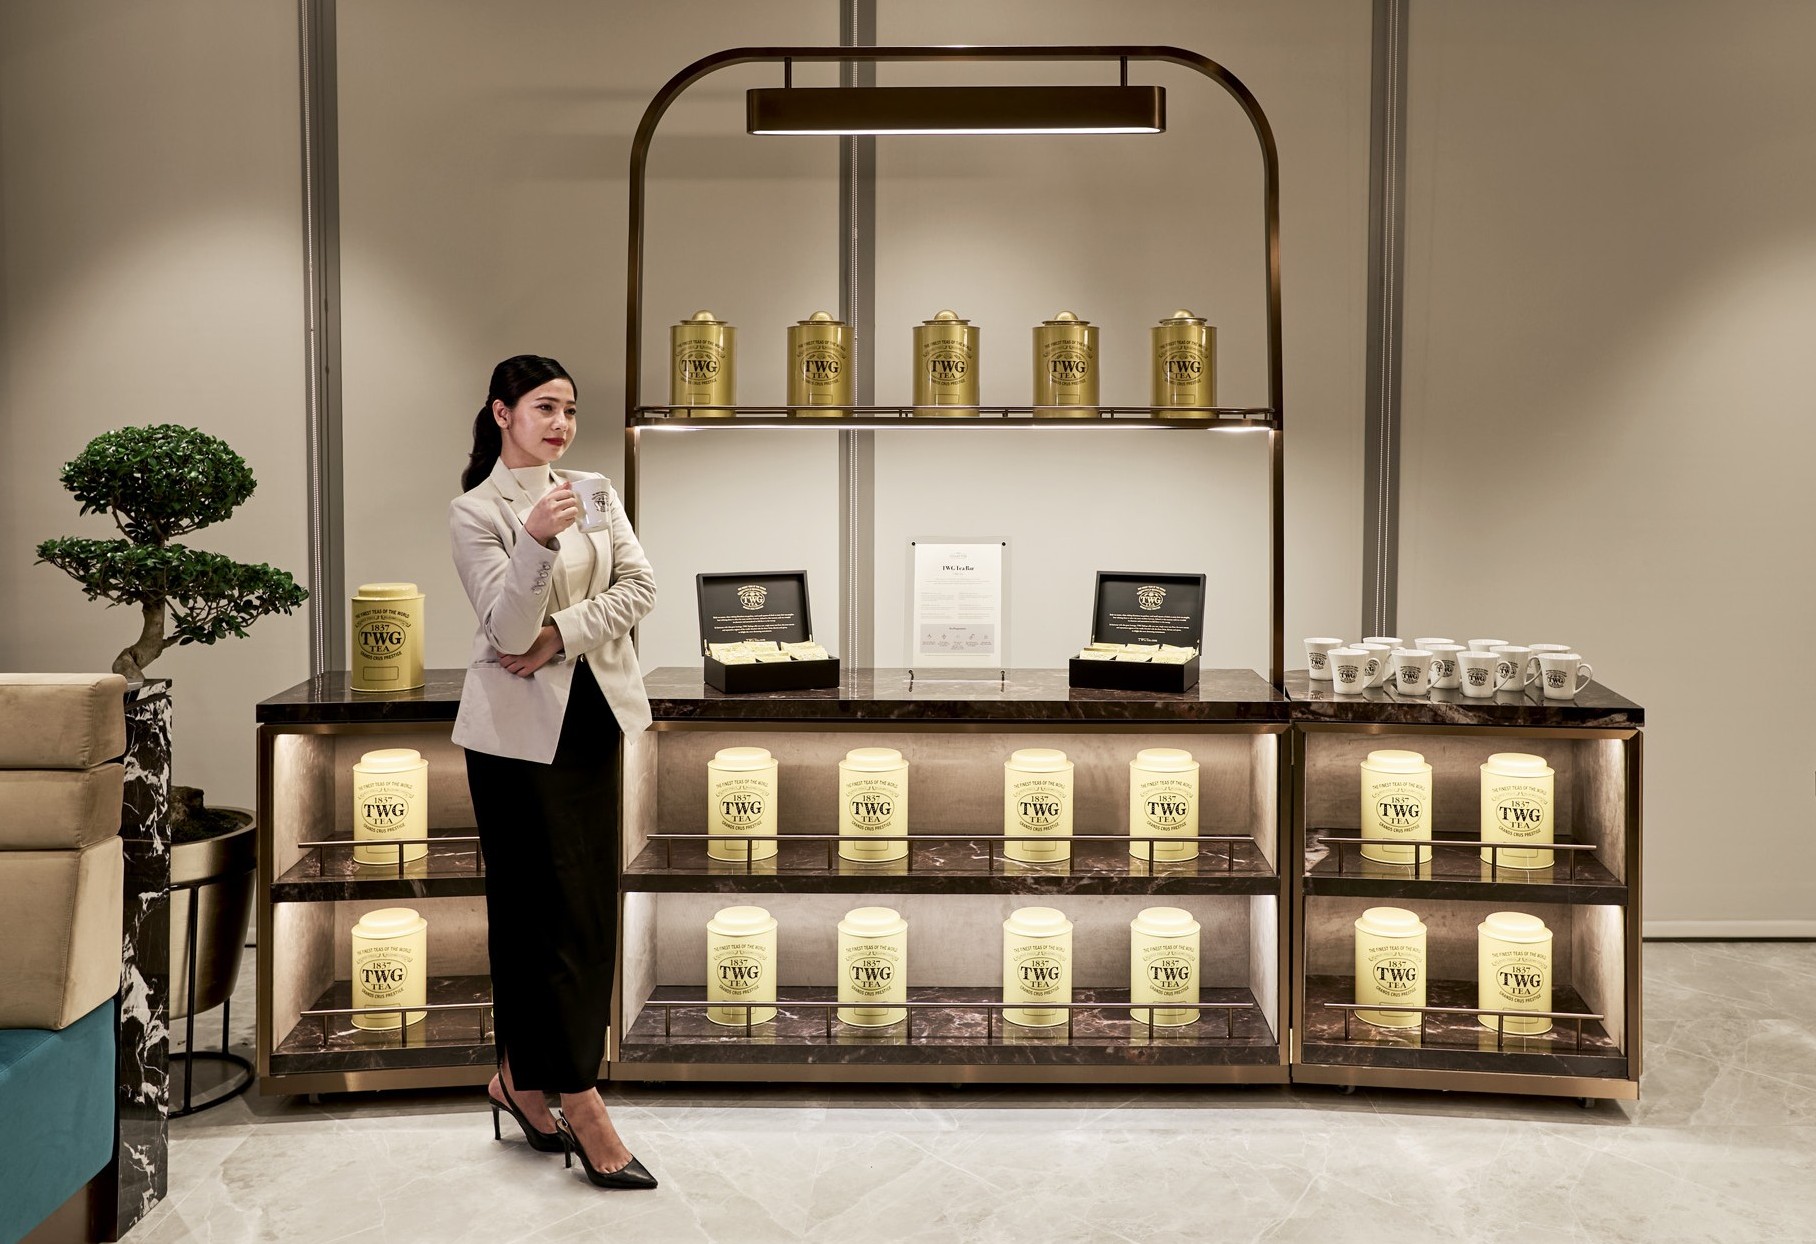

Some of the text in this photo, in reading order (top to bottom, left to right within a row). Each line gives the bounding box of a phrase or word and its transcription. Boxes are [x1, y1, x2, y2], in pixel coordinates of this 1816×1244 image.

[682, 360, 717, 373] TWG
[804, 360, 838, 373] TWG
[930, 360, 965, 373] TWG
[1051, 360, 1086, 373] TWG
[1165, 360, 1201, 373] TWG
[360, 631, 402, 645] TWG
[364, 803, 404, 817] TWG
[722, 801, 762, 815] TWG
[852, 802, 891, 815] TWG
[1020, 802, 1060, 816] TWG
[1148, 802, 1187, 815] TWG
[1380, 803, 1420, 817] TWG
[1500, 807, 1541, 822] TWG
[362, 968, 402, 983] TWG
[720, 966, 759, 979] TWG
[852, 967, 892, 980] TWG
[1021, 967, 1060, 980] TWG
[1151, 966, 1189, 980] TWG
[1377, 967, 1416, 981] TWG
[1500, 972, 1541, 987] TWG
